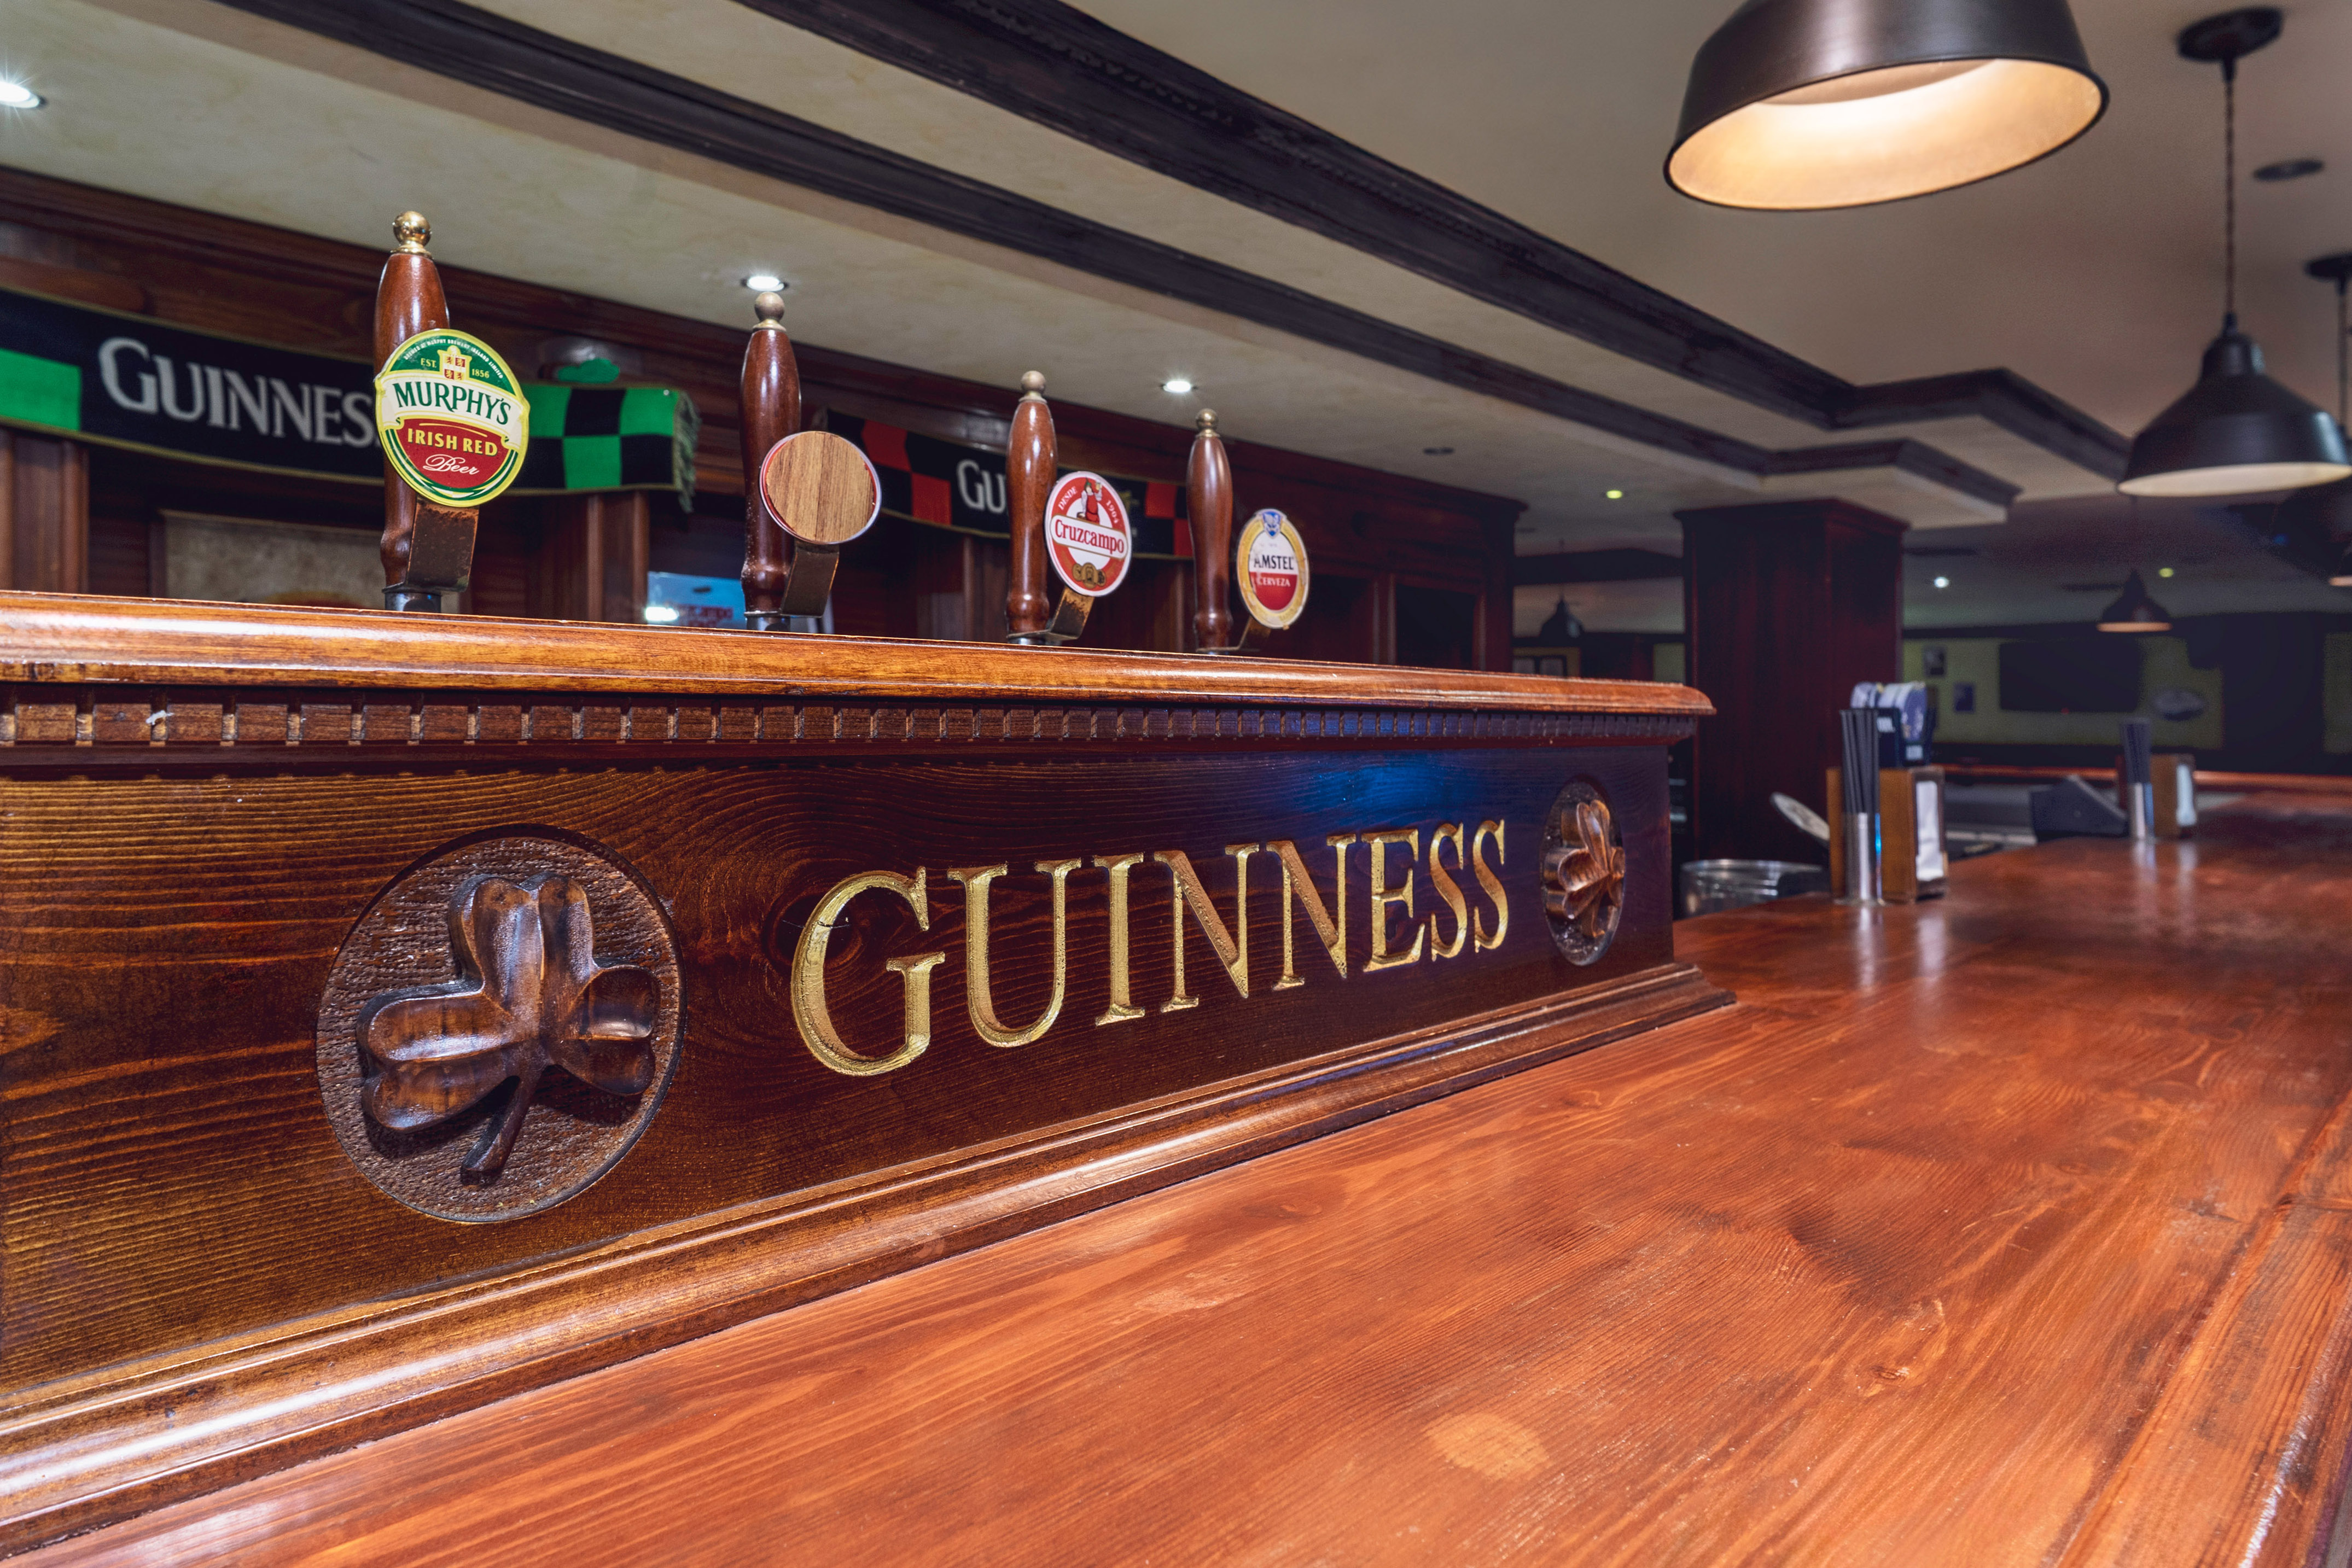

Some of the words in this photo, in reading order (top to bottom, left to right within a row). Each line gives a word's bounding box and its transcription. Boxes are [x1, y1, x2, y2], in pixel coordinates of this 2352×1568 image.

[421, 358, 436, 368] EST.
[472, 369, 490, 378] 1856
[471, 347, 490, 362] IRELAND
[488, 362, 503, 378] LIMITED
[97, 336, 381, 438] GUINNES
[392, 382, 511, 425] MURPHY'S
[407, 428, 457, 450] IRISH
[463, 436, 498, 456] RED
[423, 454, 479, 475] Beer
[1057, 486, 1078, 510] DESDE
[1106, 500, 1119, 523] 1904
[1055, 519, 1124, 555] Cruzcampo
[1254, 554, 1290, 569] AMSTEL
[1257, 577, 1291, 587] CERVEZA
[791, 818, 1507, 1077] GUINNESS
